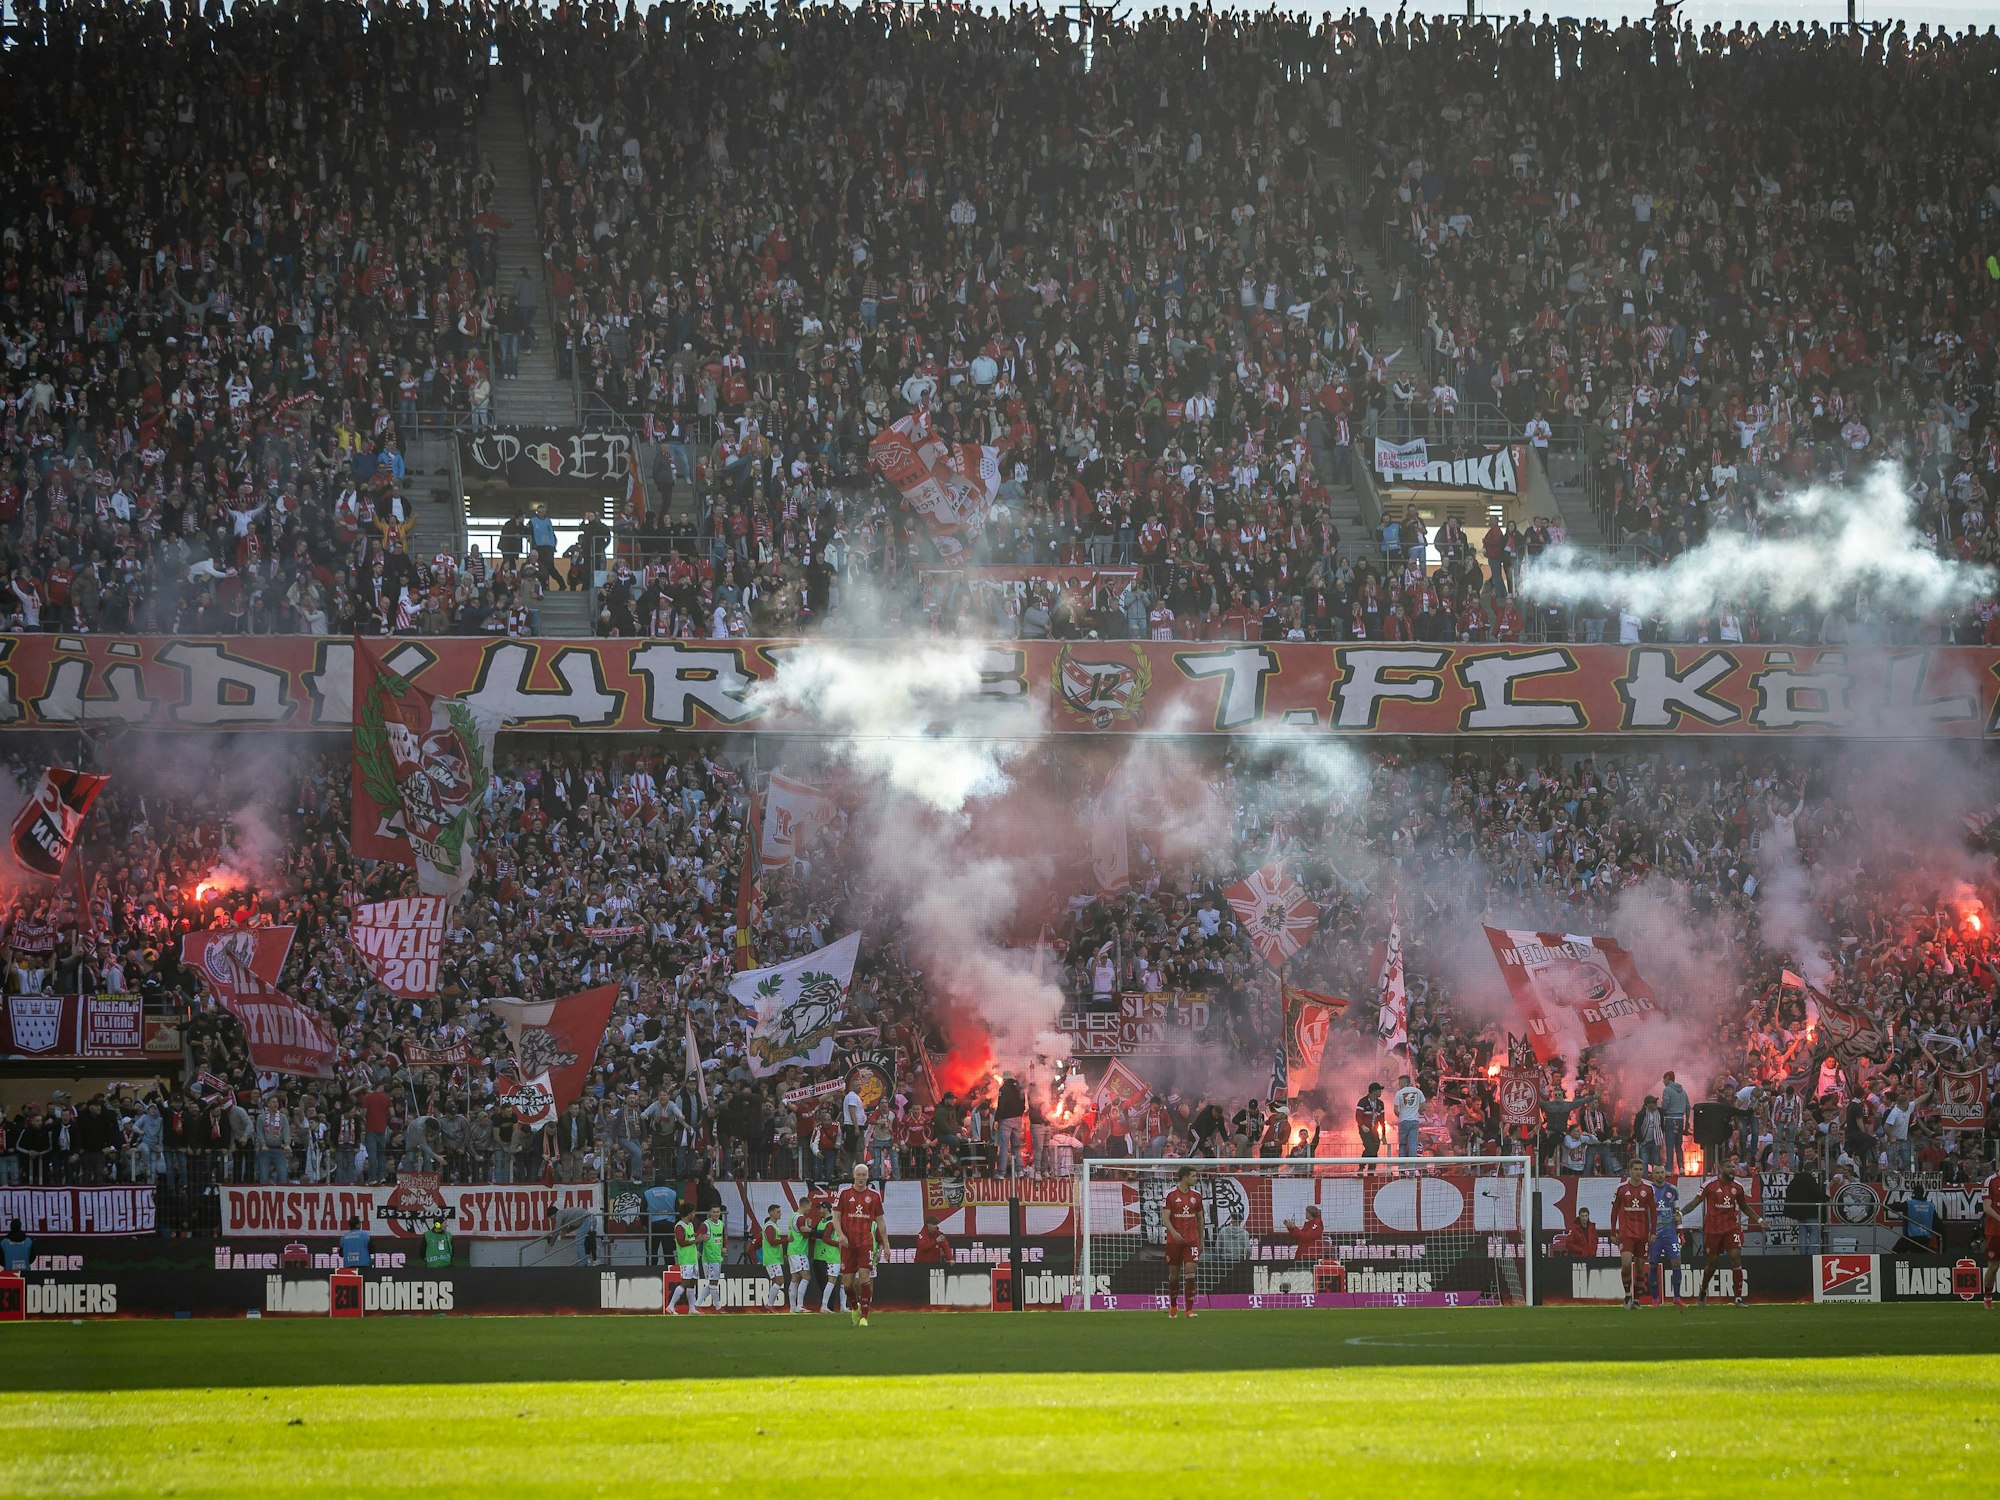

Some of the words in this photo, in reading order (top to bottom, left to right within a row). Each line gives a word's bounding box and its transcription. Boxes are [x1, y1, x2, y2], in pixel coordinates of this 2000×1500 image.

[1377, 459, 1426, 469] RASSISMUS
[1089, 672, 1121, 702] 12
[1583, 996, 1656, 1024] RHING
[79, 1188, 156, 1232] FIDELIS
[229, 1190, 374, 1232] DOMSTADT
[1190, 1246, 1199, 1256] 15
[600, 1272, 616, 1280] DAS
[1572, 1262, 1586, 1270] DAS
[267, 1274, 282, 1282] DAS
[364, 1276, 454, 1311] DÖNERS
[1854, 1275, 1870, 1293] 2
[1896, 1267, 1952, 1295] HAUS
[26, 1278, 117, 1314] DÖNERS
